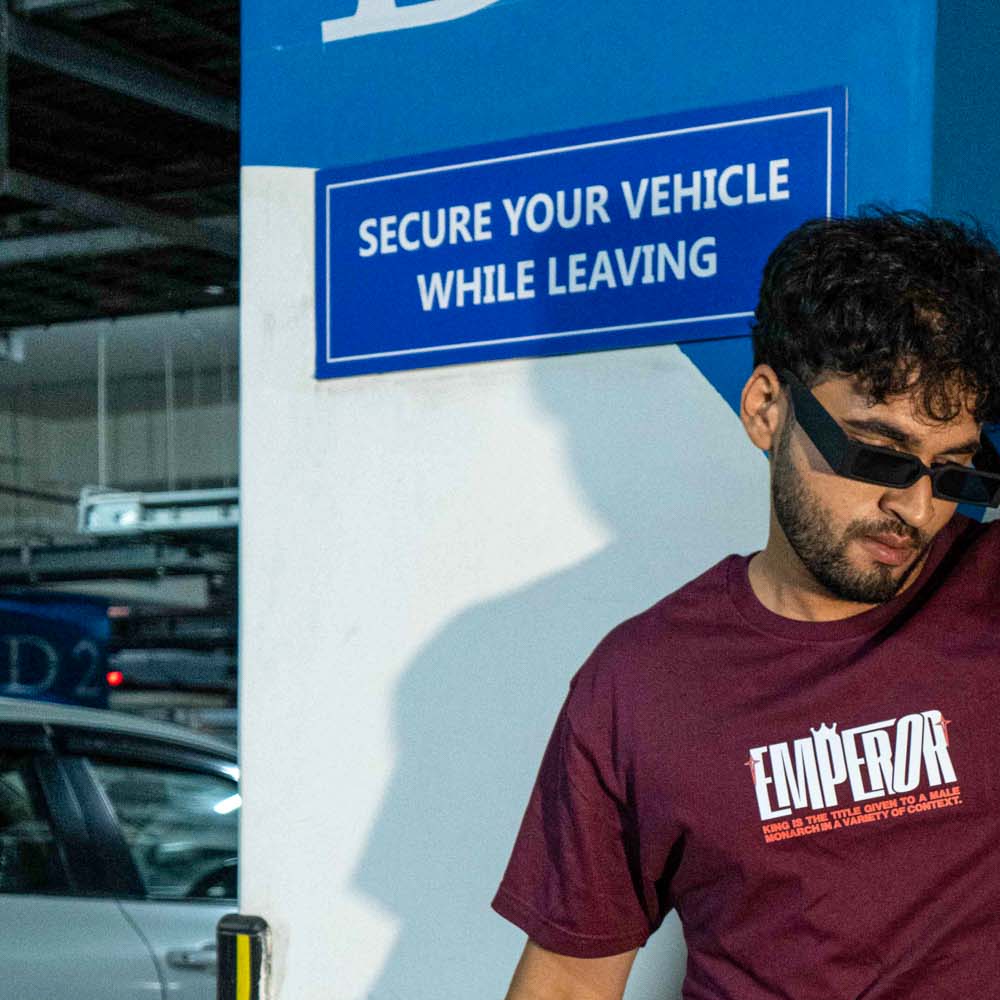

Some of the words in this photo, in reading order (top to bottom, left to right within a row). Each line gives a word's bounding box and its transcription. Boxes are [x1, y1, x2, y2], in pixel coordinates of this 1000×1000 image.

[358, 201, 492, 257] SECURE
[502, 185, 610, 236] YOUR
[621, 158, 790, 219] VEHICLE
[417, 259, 535, 311] WHILE
[548, 236, 717, 295] LEAVING
[5, 634, 102, 697] D2
[749, 709, 958, 821] EMPEROR
[762, 821, 790, 834] KING
[792, 817, 804, 829] IS
[805, 812, 829, 825] THE
[830, 806, 862, 820] TITLE
[863, 798, 897, 813] GIVEN
[899, 795, 916, 806] TO
[918, 793, 928, 803] A
[929, 786, 961, 799] MALE
[764, 824, 820, 844] MONARCH
[820, 821, 833, 832] IN
[833, 819, 842, 829] A
[842, 810, 889, 827] VARIETY
[890, 806, 906, 817] OF
